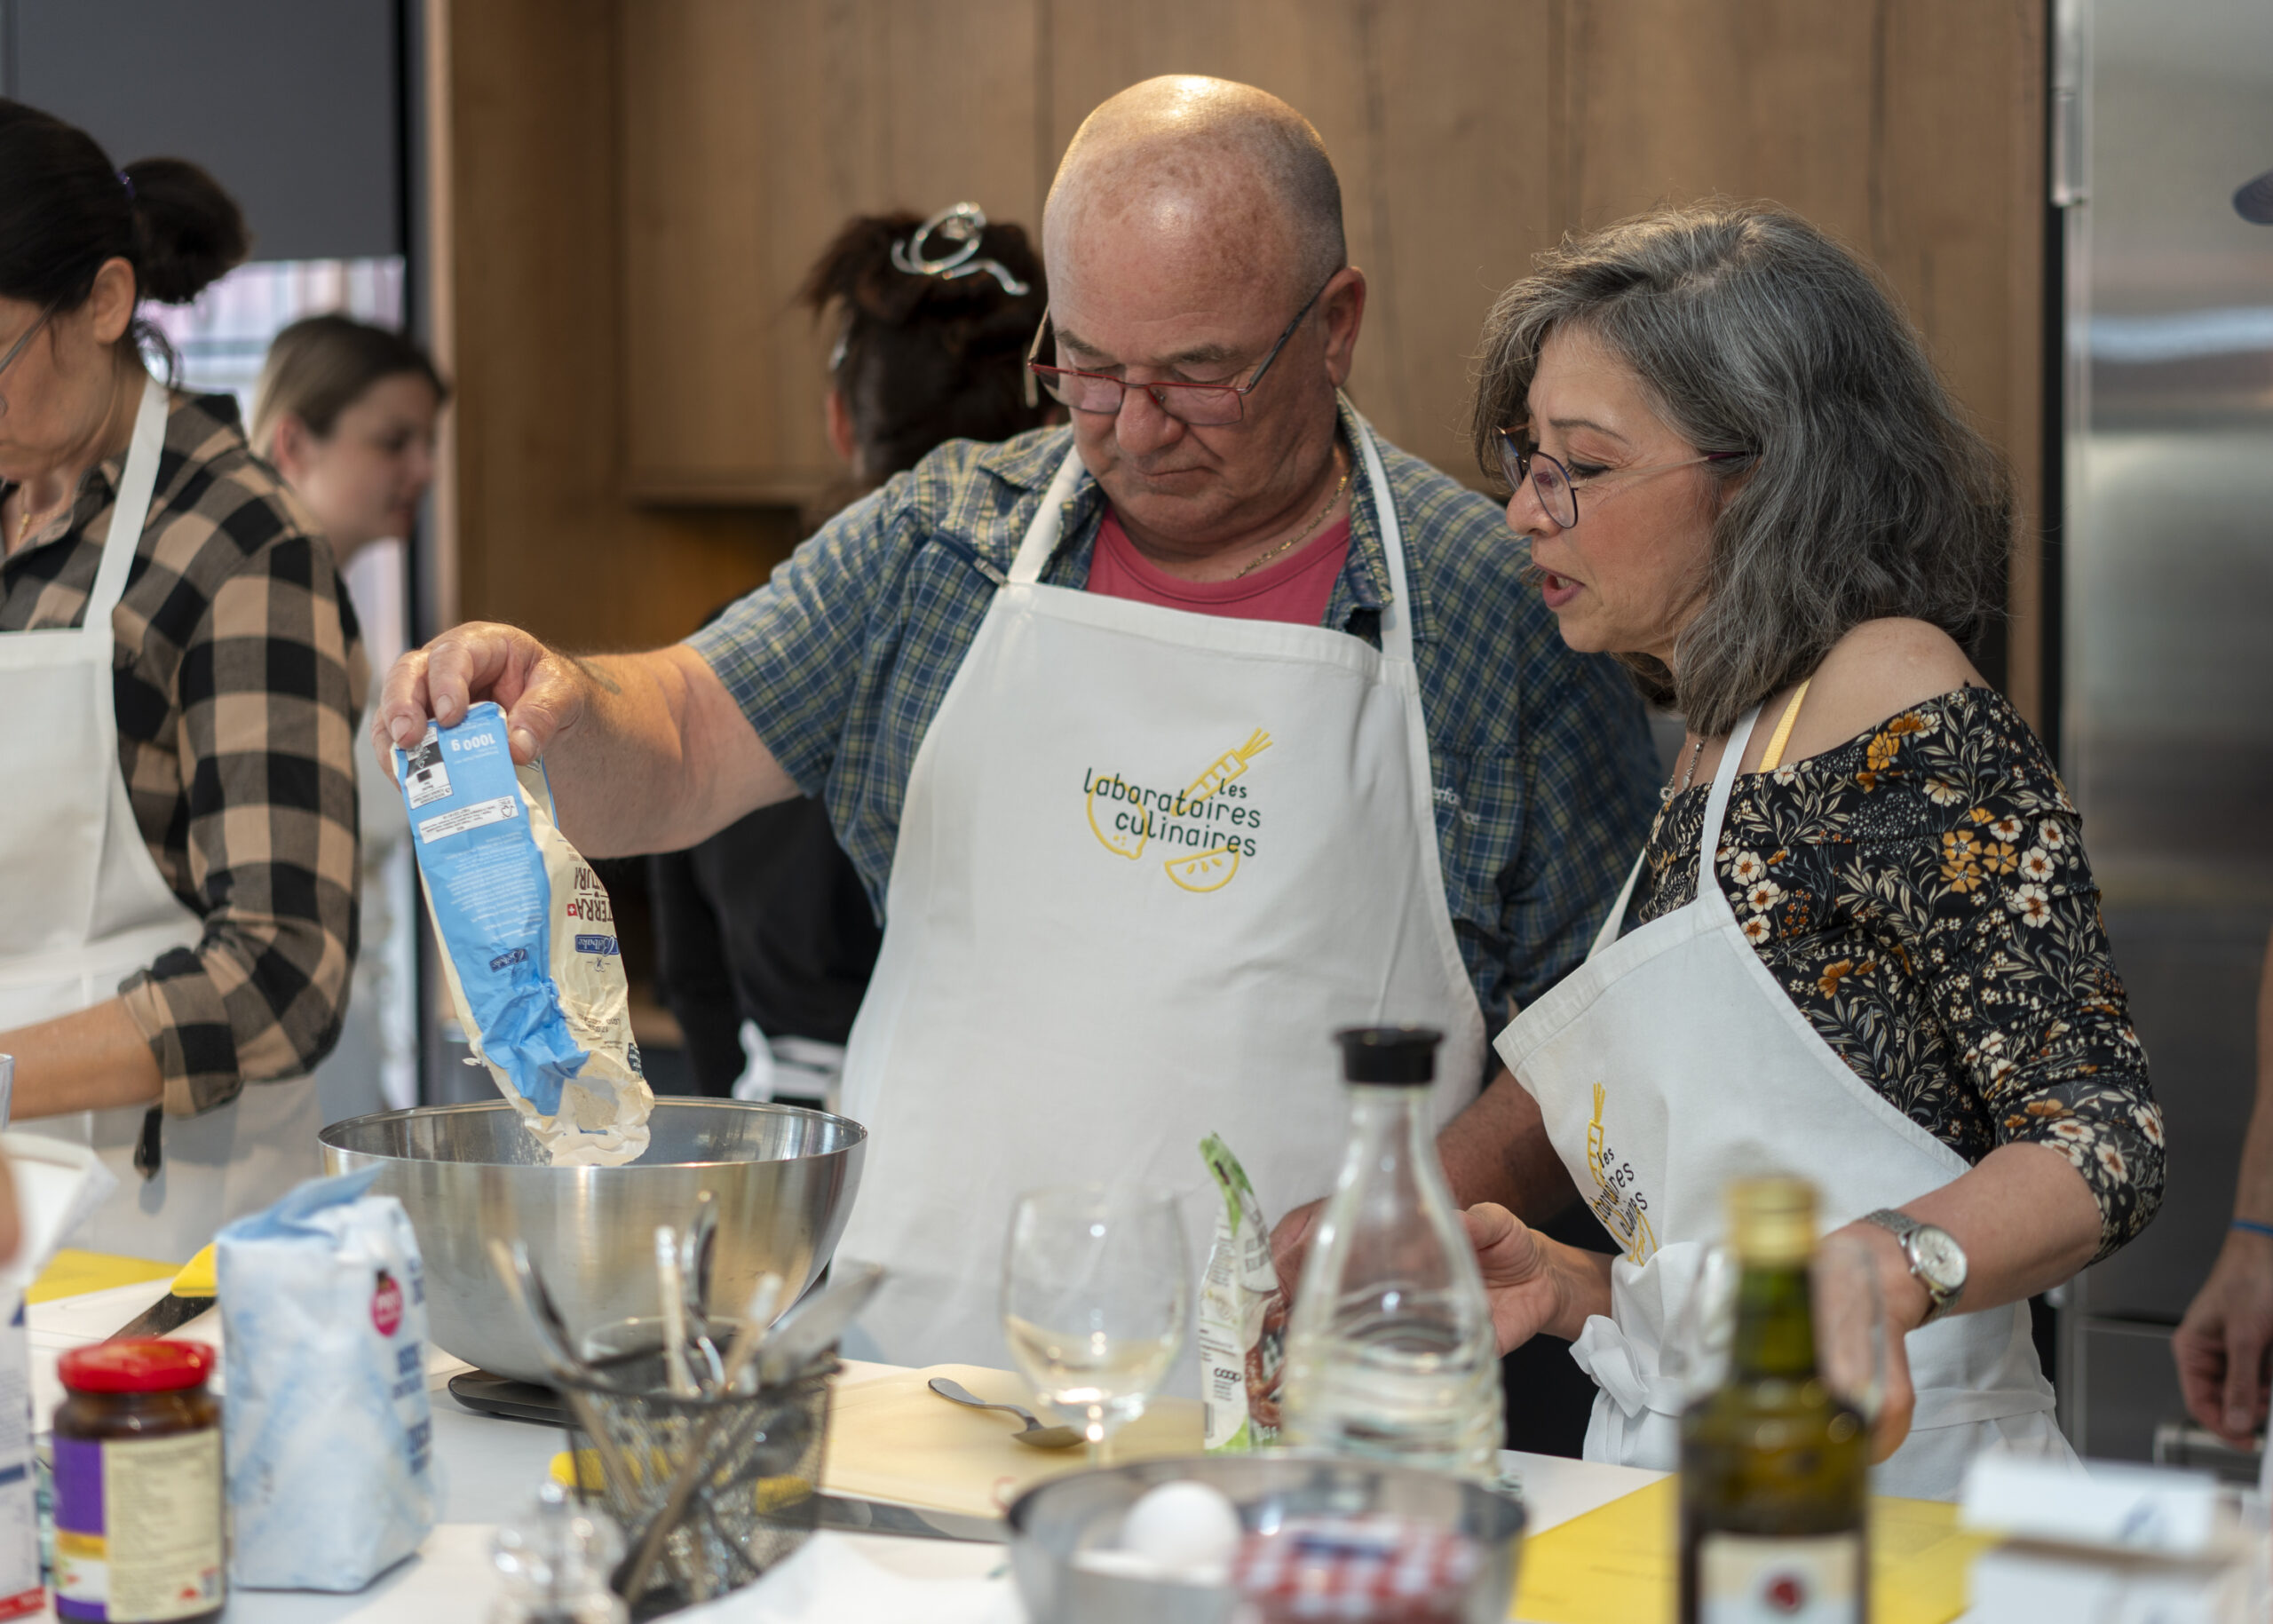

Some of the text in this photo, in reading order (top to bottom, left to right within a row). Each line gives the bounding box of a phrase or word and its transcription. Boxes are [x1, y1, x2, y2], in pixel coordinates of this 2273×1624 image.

[451, 733, 496, 752] 1000 g
[1083, 767, 1262, 828] laboratoires
[1218, 778, 1247, 799] les
[1115, 811, 1257, 858] culinaires
[575, 899, 614, 923] TERRA
[576, 935, 616, 957] Belbake
[1597, 1148, 1615, 1169] les
